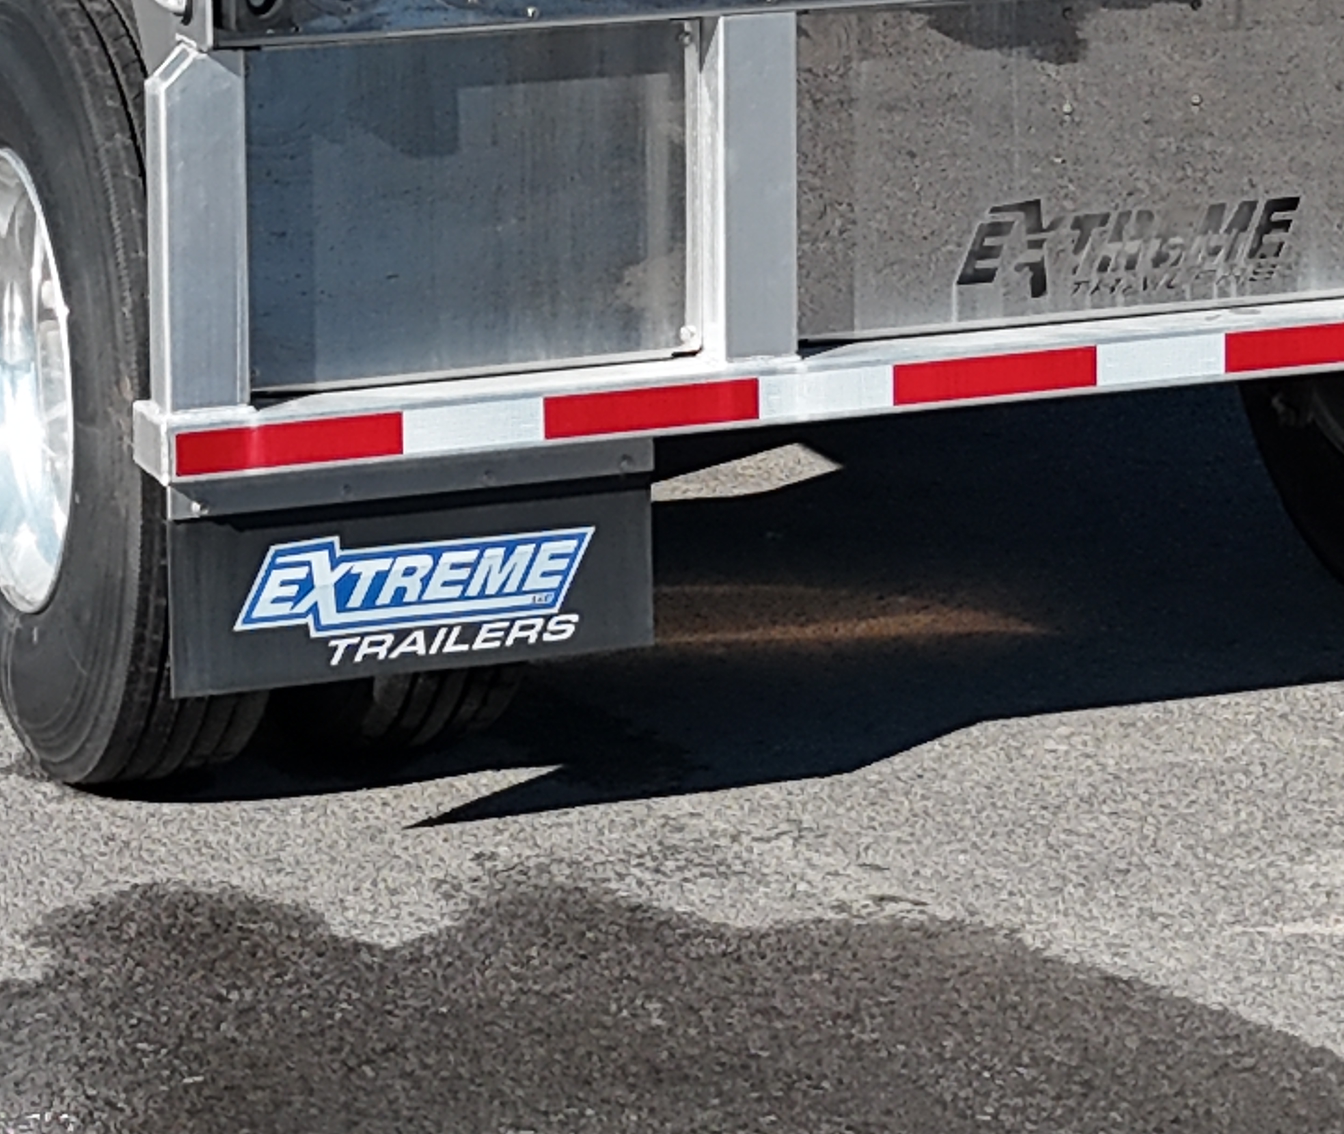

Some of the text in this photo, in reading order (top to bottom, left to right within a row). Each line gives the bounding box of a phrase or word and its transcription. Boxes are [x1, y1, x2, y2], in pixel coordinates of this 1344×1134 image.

[956, 195, 1302, 299] EXTREME
[248, 539, 580, 625] EXTREME
[328, 613, 580, 667] TRAILERS
